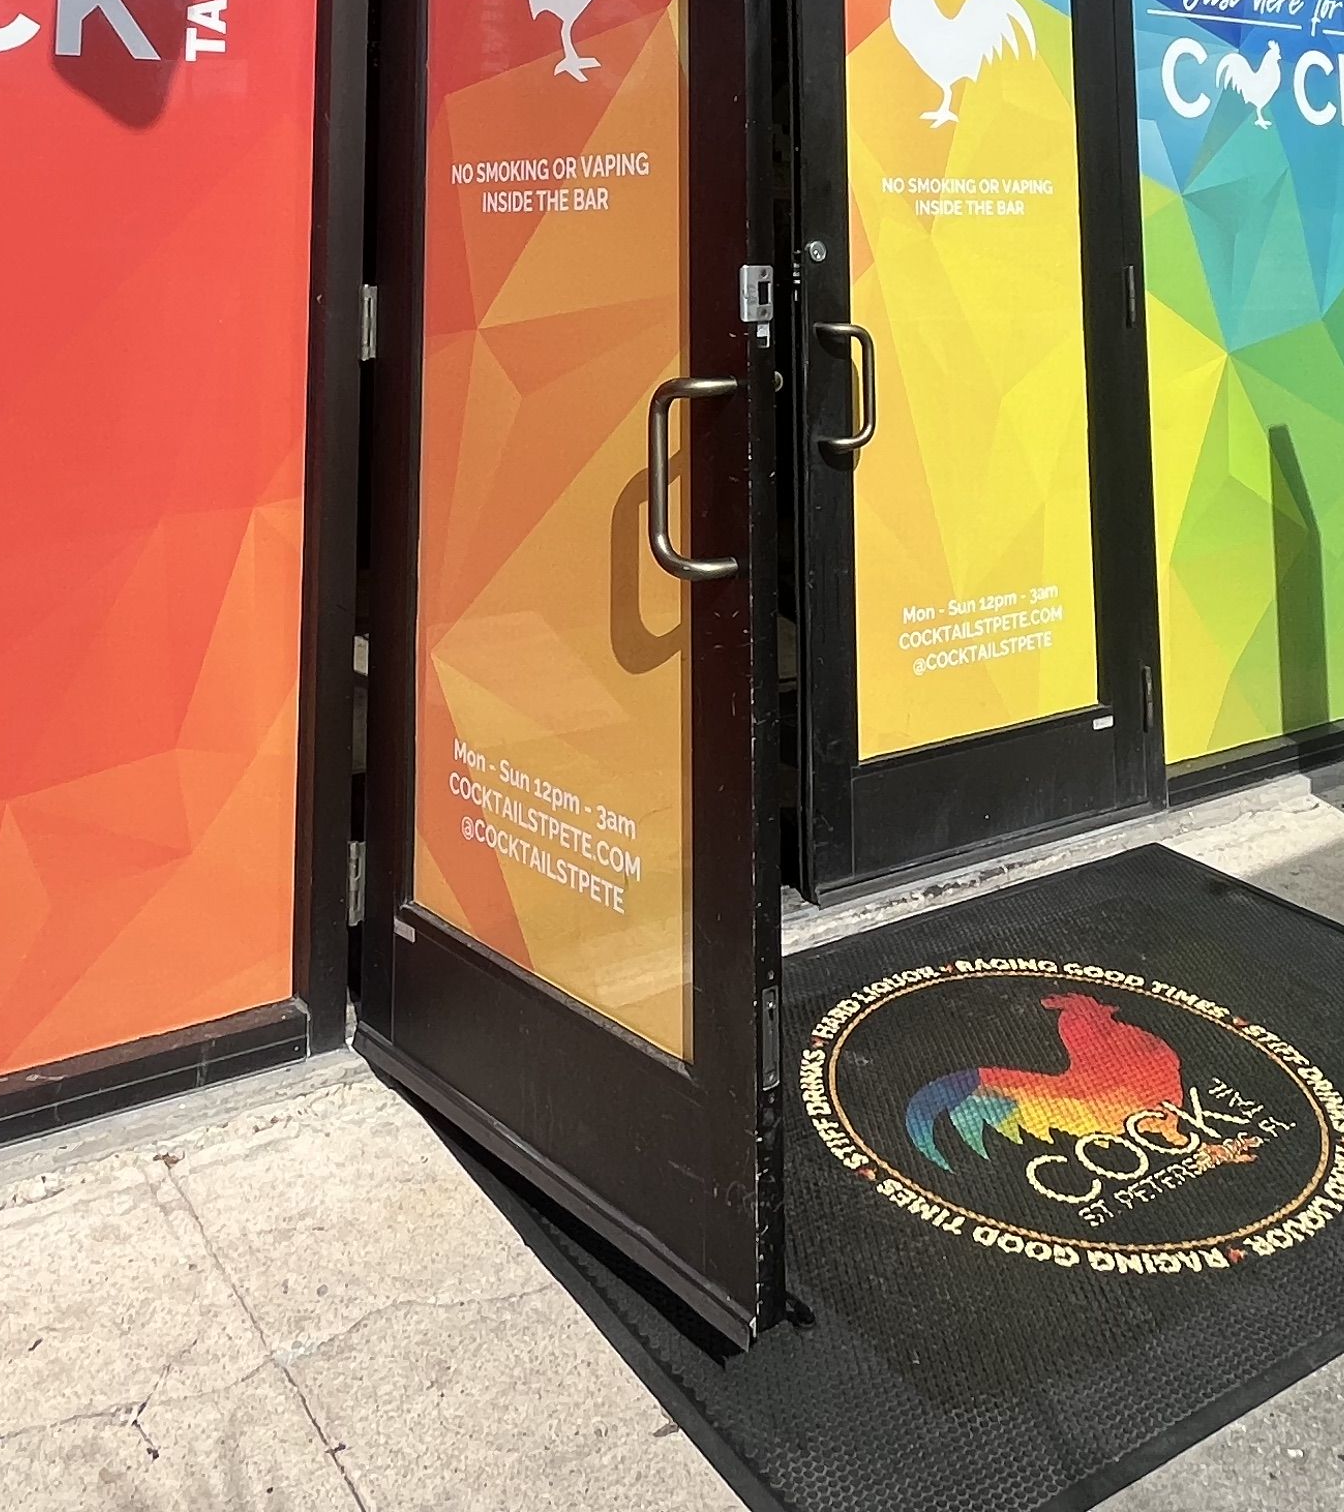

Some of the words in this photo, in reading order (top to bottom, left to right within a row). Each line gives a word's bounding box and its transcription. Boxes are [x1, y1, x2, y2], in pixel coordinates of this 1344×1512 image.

[452, 163, 473, 185] NO
[476, 158, 549, 183] SMOKING
[552, 157, 577, 180] OR
[580, 152, 649, 178] VAPING
[881, 177, 906, 194] NO
[908, 178, 977, 195] SMOKING
[978, 178, 1000, 194] OR
[1001, 178, 1053, 195] VAPING
[482, 190, 533, 213] INSIDE
[536, 189, 569, 212] THE
[574, 187, 609, 210] BAR
[915, 200, 962, 216] INSIDE
[965, 200, 993, 215] THE
[997, 200, 1025, 215] BAR
[903, 605, 935, 624] Mon
[948, 599, 976, 616] Sun
[979, 591, 1018, 612] 12pm
[1030, 584, 1059, 604] 3am
[898, 605, 1063, 651] COCKTAILSTPETE.COM
[912, 631, 1053, 676] @COCKTAILSTPETE
[454, 738, 486, 772] Mon
[499, 759, 530, 793] Sun
[533, 777, 580, 815] 12pm
[596, 805, 637, 840] 3am
[448, 772, 642, 882] COCKTAILSTPETE.COM
[461, 816, 626, 915] @COCKTAILSTPETE
[812, 999, 860, 1039] HARD
[852, 965, 940, 1009] LIQUOR
[955, 958, 1056, 972] RAGING
[1063, 962, 1144, 987] GOOD
[1151, 980, 1230, 1019] TIMES
[1244, 1025, 1309, 1068] STIFF
[800, 1049, 831, 1115] DRINKS
[812, 1117, 869, 1169] STIFF
[1025, 1086, 1251, 1204] COCK
[876, 1178, 966, 1235] TIMES
[972, 1225, 1079, 1267] GOOD
[1087, 1247, 1230, 1274] RAGING
